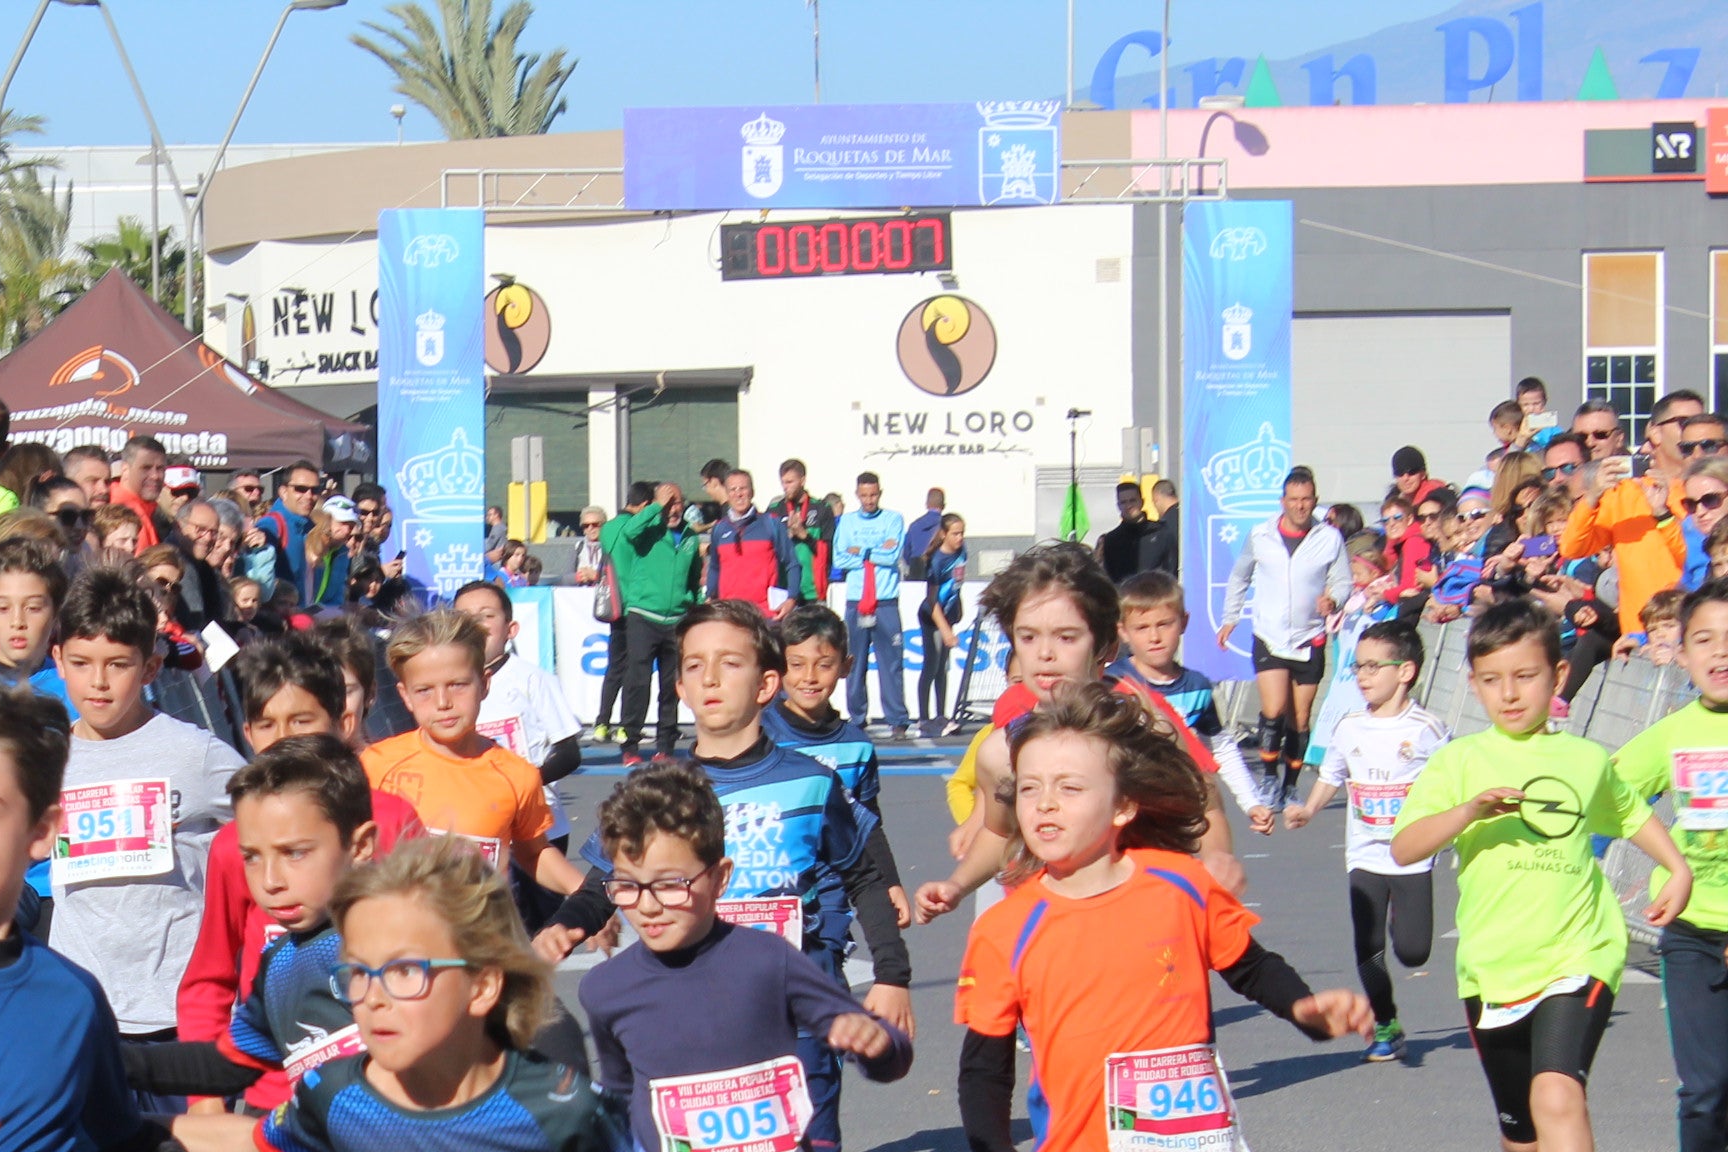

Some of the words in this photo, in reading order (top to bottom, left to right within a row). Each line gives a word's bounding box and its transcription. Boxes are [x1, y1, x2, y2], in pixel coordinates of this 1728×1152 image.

[819, 132, 909, 145] AYUNTAMIENTO
[911, 132, 927, 144] DE
[793, 147, 879, 167] ROQUETAS
[884, 149, 906, 164] DE
[273, 290, 334, 337] NEW
[862, 412, 928, 436] NEW
[944, 410, 1034, 437] LORO
[154, 430, 227, 456] meta
[911, 444, 956, 456] SNACK
[958, 443, 985, 455] BAR
[1368, 767, 1390, 781] Fly
[77, 787, 109, 800] CARRERA
[65, 800, 91, 812] CIUDAD
[91, 799, 102, 809] DE
[1363, 798, 1401, 816] 918
[77, 808, 133, 841] 951
[730, 850, 791, 867] EDIA
[1534, 848, 1566, 860] OPEL
[1507, 860, 1561, 873] SALINAS
[1563, 863, 1583, 876] CAR
[732, 867, 799, 890] ATÓN
[716, 903, 744, 914] ARRERA
[744, 902, 778, 912] POPULAR
[725, 914, 736, 923] DE
[736, 911, 775, 922] ROQUETAS
[303, 1043, 341, 1070] POPULAR
[1133, 1058, 1149, 1069] VIII
[1150, 1053, 1188, 1068] CARRERA
[1133, 1068, 1166, 1081] CIUDAD
[1167, 1067, 1180, 1079] DE
[677, 1084, 693, 1097] VIII
[695, 1077, 739, 1095] CARRERA
[679, 1095, 715, 1110] CIUDAD
[716, 1093, 730, 1105] DE
[730, 1083, 776, 1103] ROQUETAS
[1149, 1077, 1219, 1118] 946
[697, 1100, 778, 1146] 905
